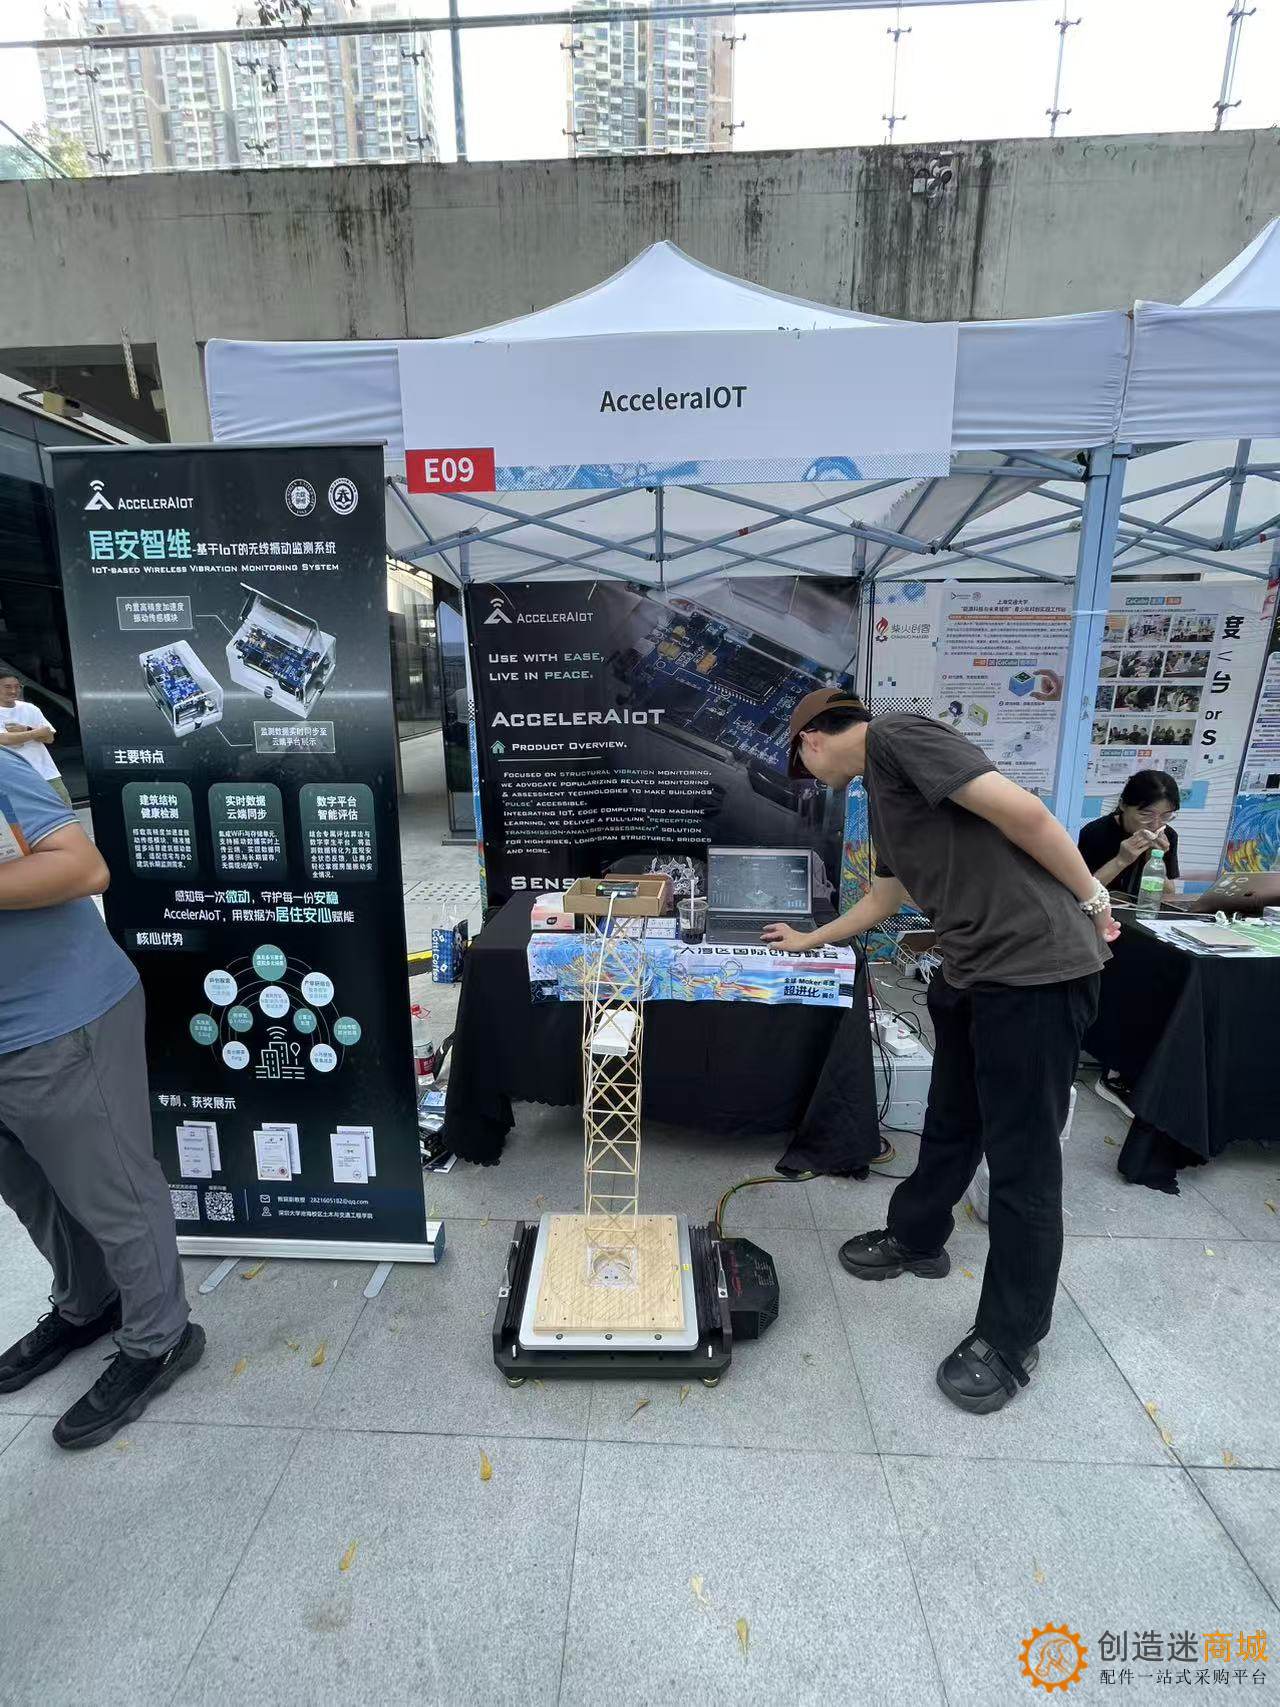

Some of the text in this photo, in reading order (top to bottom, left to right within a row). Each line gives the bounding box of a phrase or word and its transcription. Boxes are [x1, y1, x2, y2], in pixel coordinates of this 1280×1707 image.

[600, 386, 748, 413] AcceleraIOT
[423, 456, 474, 483] E09
[114, 749, 165, 765] 主要特点
[139, 794, 178, 806] 建筑结构
[225, 795, 266, 807] 实时数据
[316, 795, 357, 807] 数字平台
[141, 807, 179, 819] 健康检测
[226, 808, 268, 819] 云端同步
[318, 808, 358, 820] 智能评估
[136, 931, 184, 946] 核心优势
[158, 1093, 237, 1110] 专利、获奖展示
